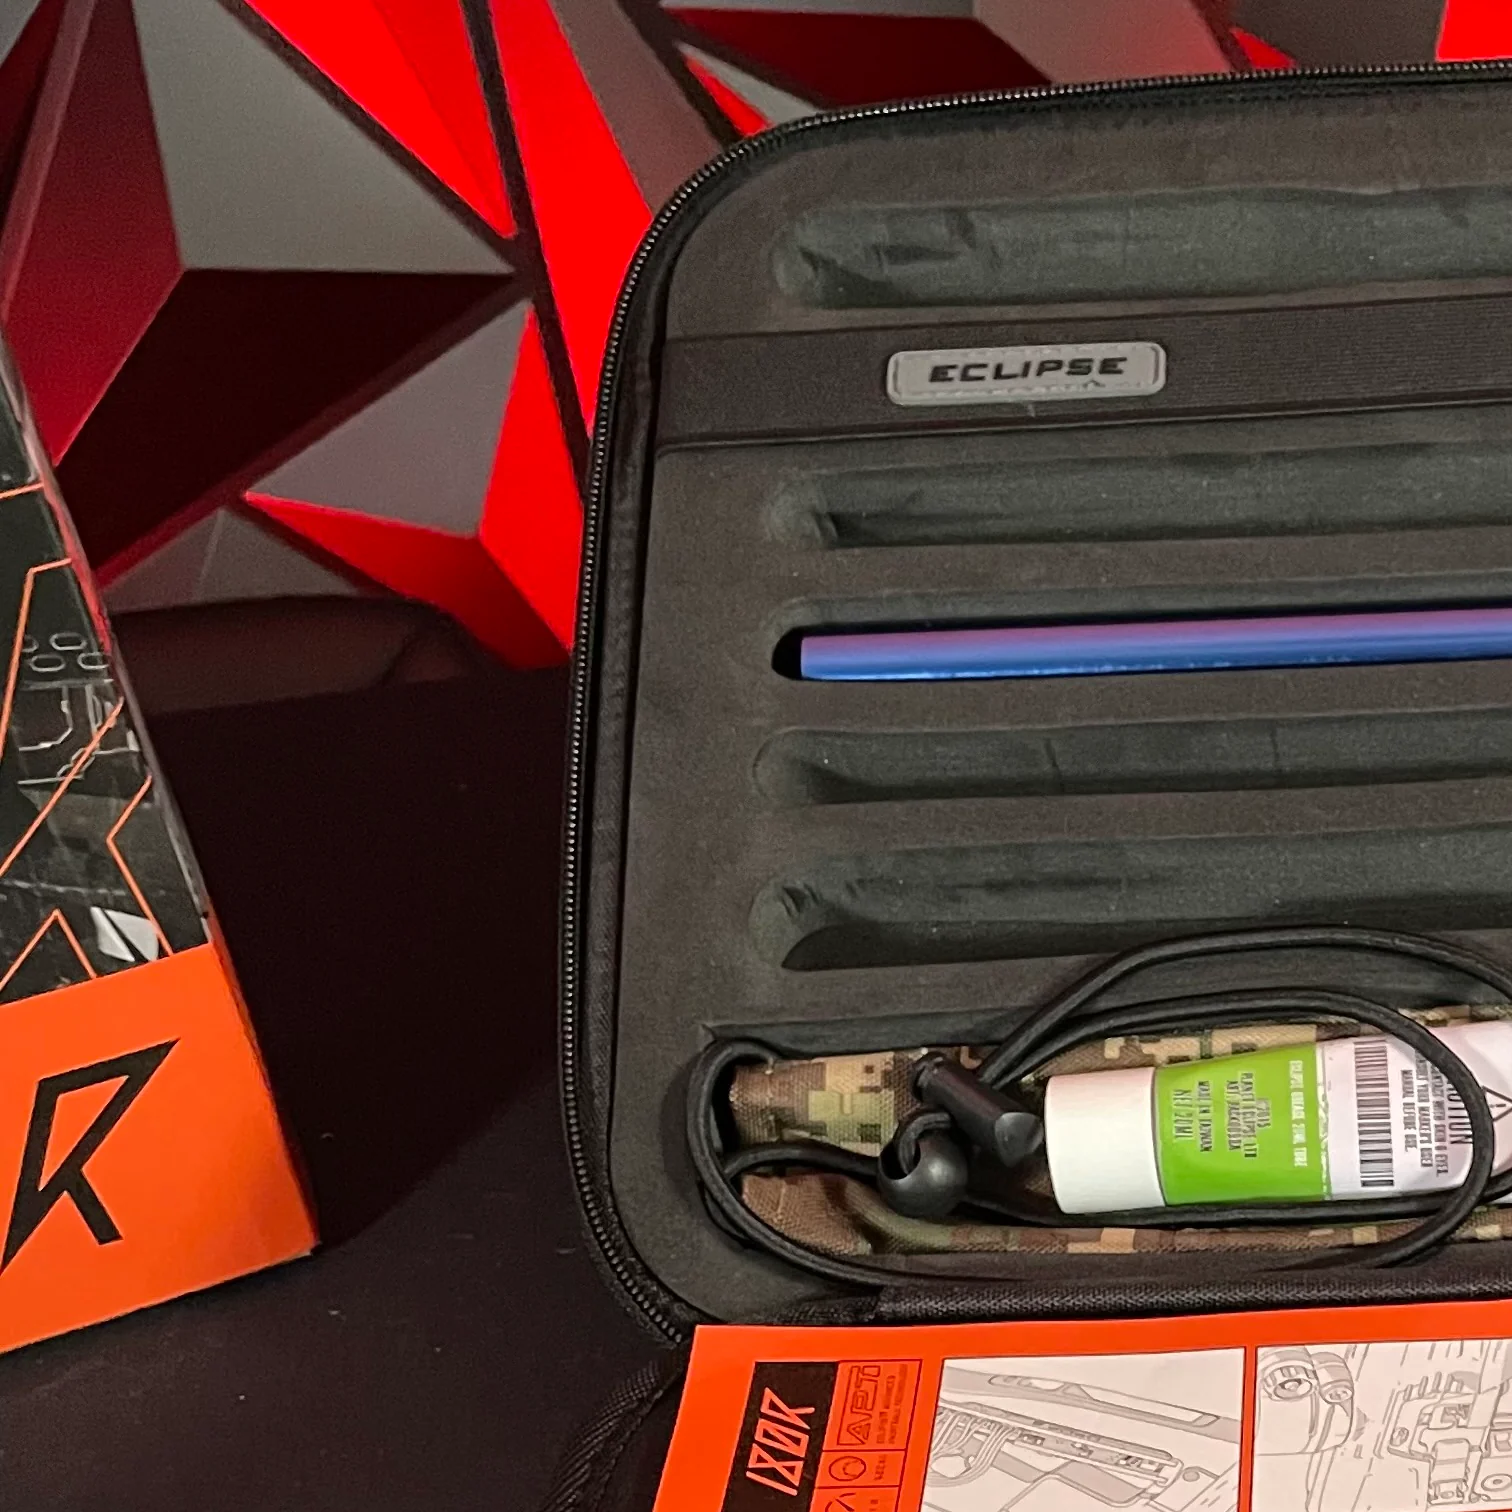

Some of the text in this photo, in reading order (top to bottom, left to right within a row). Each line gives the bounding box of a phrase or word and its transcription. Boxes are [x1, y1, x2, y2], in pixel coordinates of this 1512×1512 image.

[929, 357, 1128, 383] ECLIPSE
[1240, 1072, 1255, 1102] PLANET
[1289, 1060, 1304, 1089] ECLIPSE
[1401, 1069, 1415, 1098] MANUAL
[1173, 1089, 1195, 1138] NET 20ML
[1197, 1080, 1212, 1152] MADE IN TAIWAN
[1242, 1105, 1256, 1138] ECLIPSE
[1402, 1102, 1417, 1130] BEFORE
[1433, 1100, 1446, 1121] WITH
[1447, 1082, 1473, 1145] UTION
